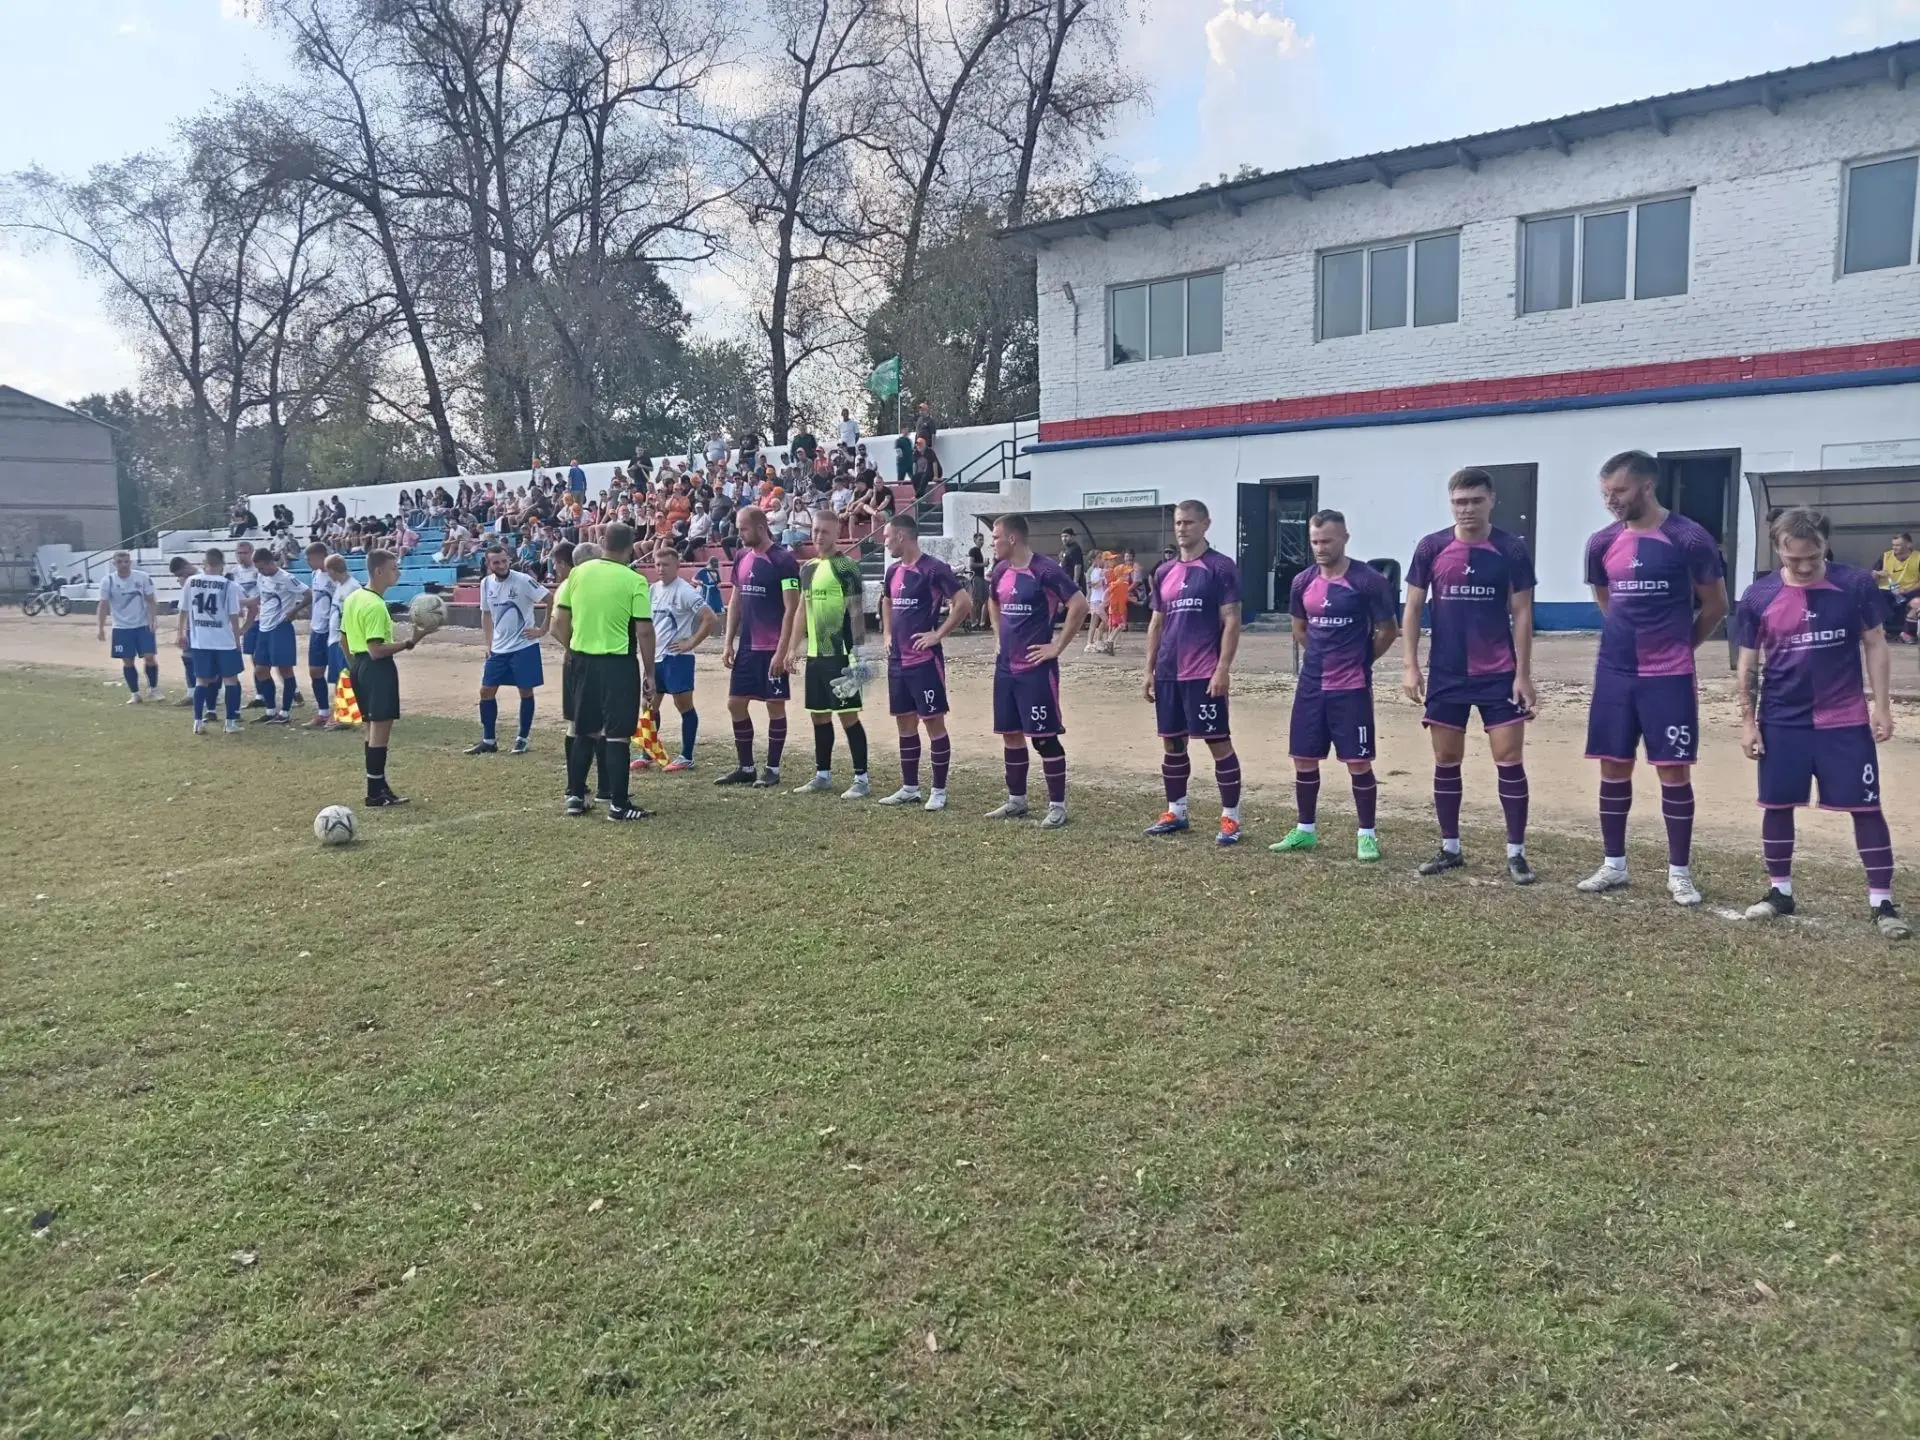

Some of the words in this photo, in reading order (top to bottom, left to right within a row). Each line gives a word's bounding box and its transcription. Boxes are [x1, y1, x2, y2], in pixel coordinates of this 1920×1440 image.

[742, 584, 766, 592] EGIDA
[1450, 585, 1496, 595] EGIDA
[1617, 580, 1669, 590] EGIDA
[194, 592, 218, 615] 14
[1791, 628, 1846, 643] EGIDA
[114, 644, 124, 653] 10
[924, 690, 935, 704] 19
[1031, 705, 1047, 721] 55
[1198, 704, 1217, 720] 33
[1358, 726, 1367, 744] 11
[1667, 725, 1690, 746] 95
[1862, 763, 1875, 784] 8
